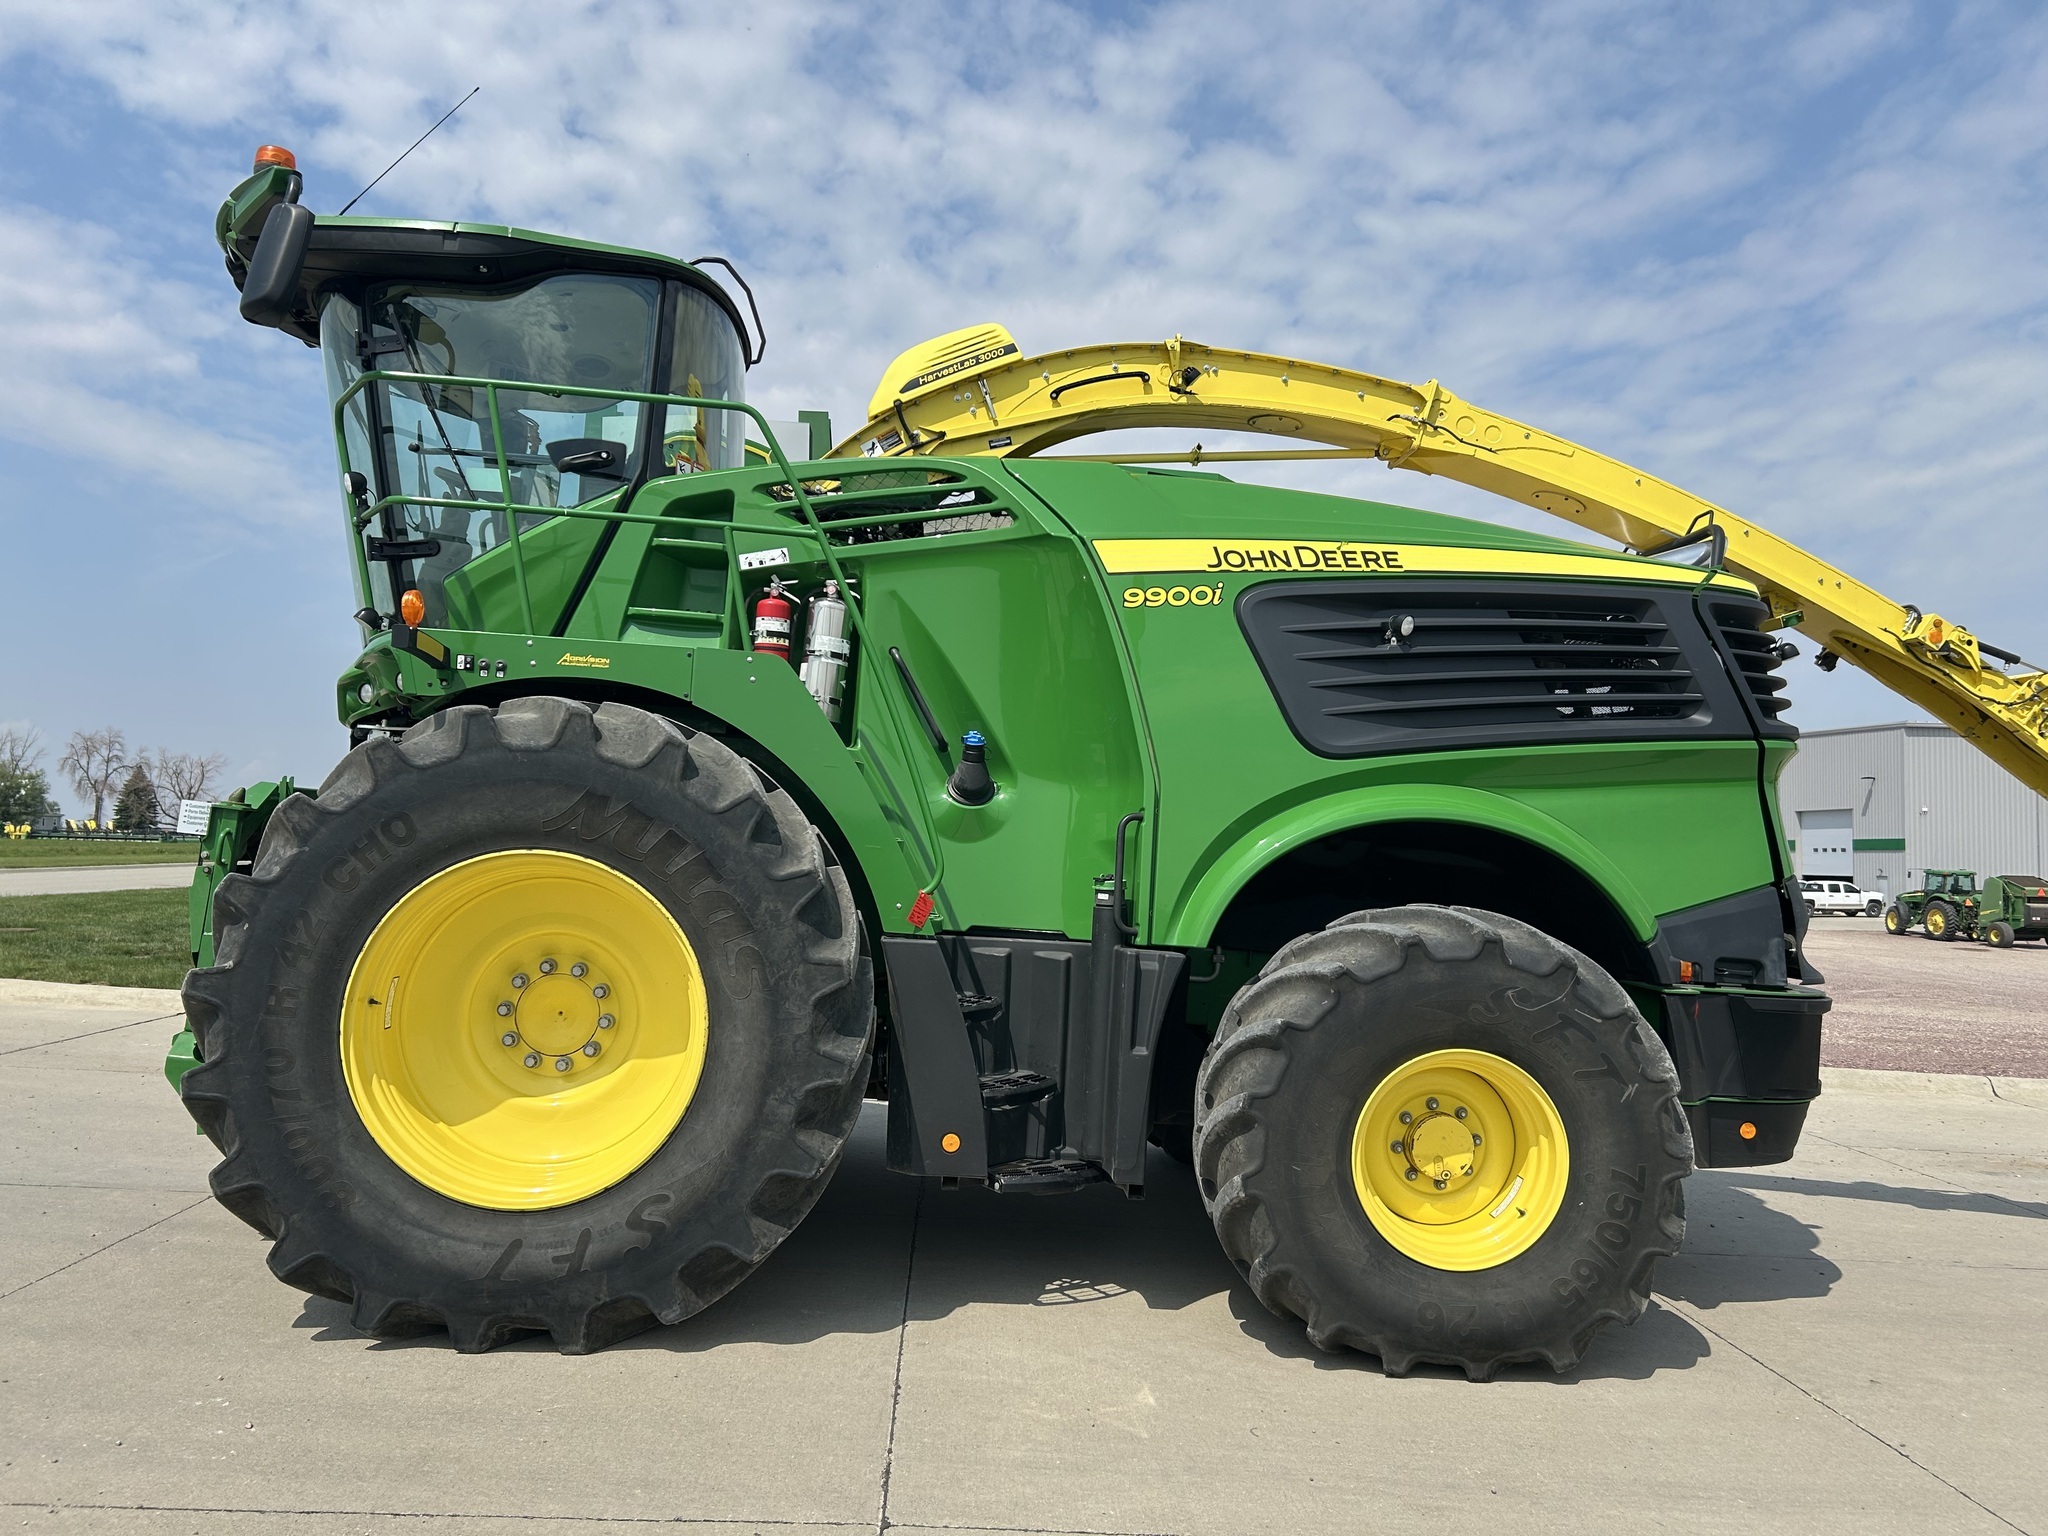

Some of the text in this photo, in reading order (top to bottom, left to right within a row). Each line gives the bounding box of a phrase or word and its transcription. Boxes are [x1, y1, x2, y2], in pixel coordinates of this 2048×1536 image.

[918, 347, 1005, 385] HarvestLab 3000
[1206, 545, 1404, 569] JOHN DEERE
[1122, 581, 1225, 609] 9900i
[275, 907, 328, 972] 42
[321, 809, 418, 894] CHO
[541, 784, 773, 1001] Mitas
[1549, 1162, 1648, 1315] 750/65
[1412, 1300, 1481, 1339] 26
